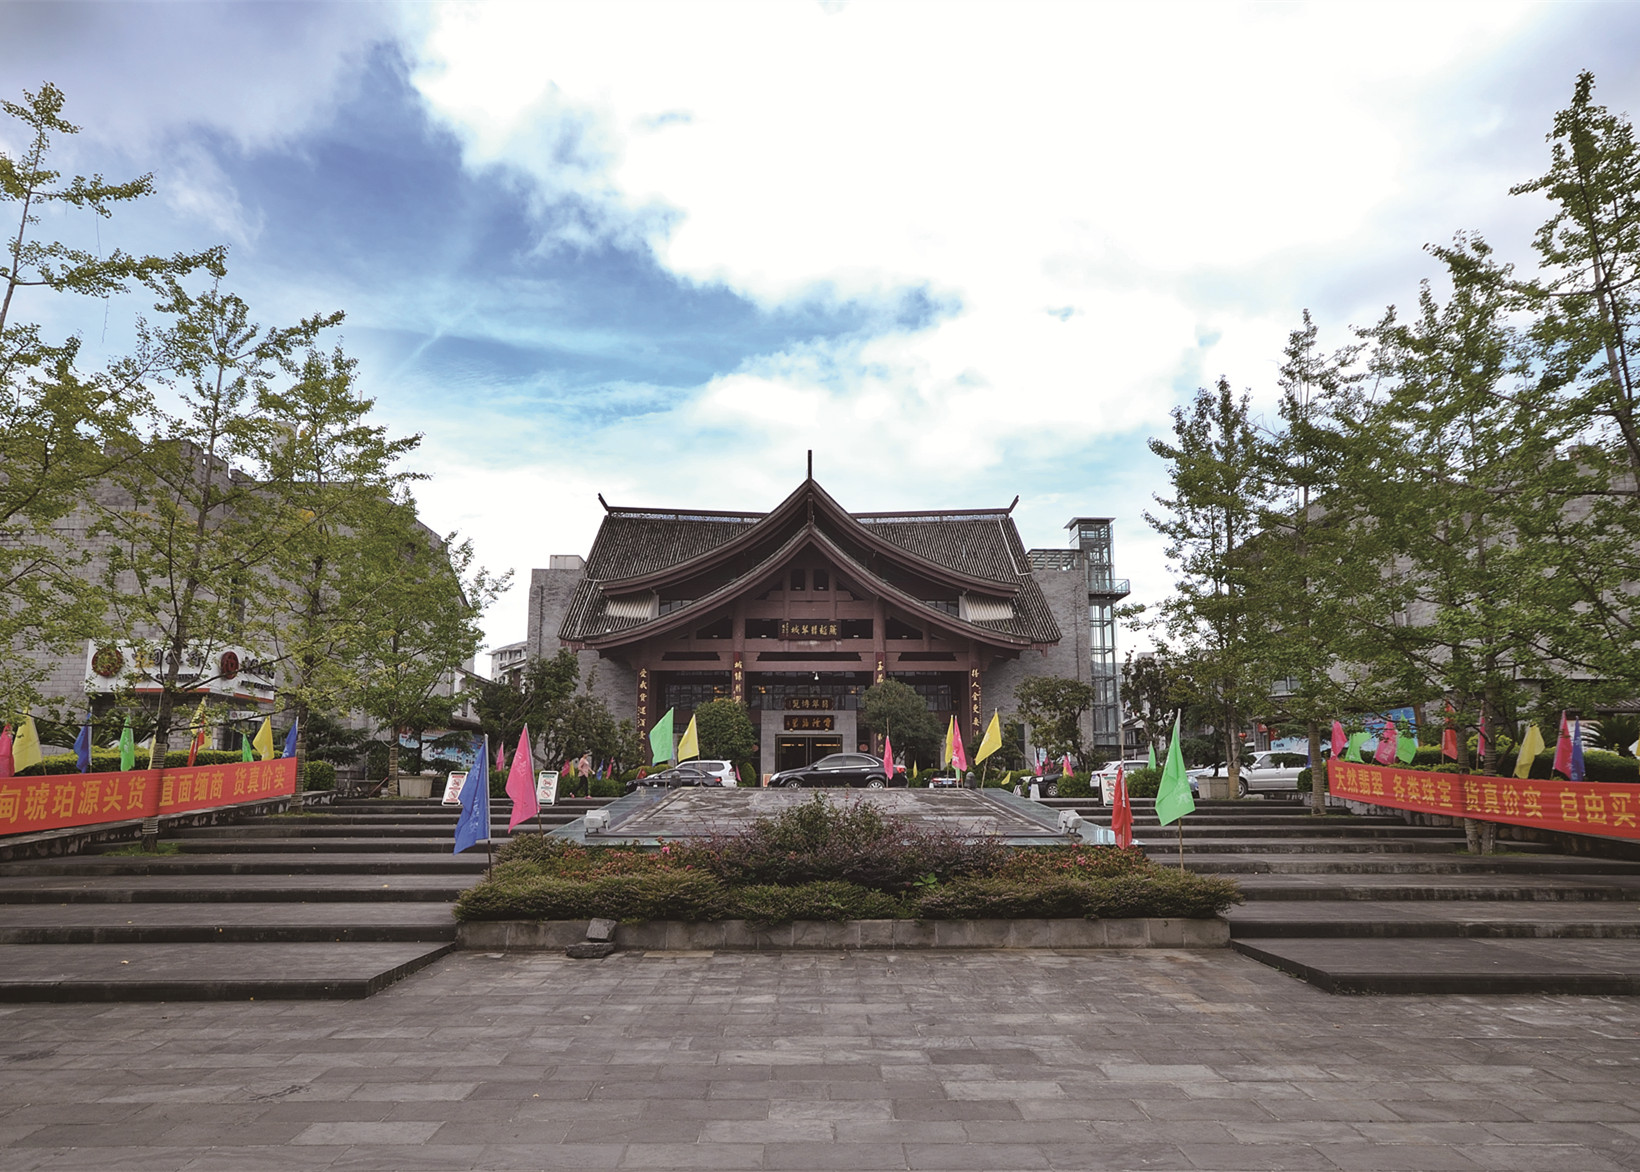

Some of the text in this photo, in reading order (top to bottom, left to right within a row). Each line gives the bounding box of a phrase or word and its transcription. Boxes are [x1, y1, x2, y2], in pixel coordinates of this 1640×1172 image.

[0, 763, 285, 824] 甸琥珀源头货 直面缅商 货真价实
[1335, 766, 1640, 829] 天然翡翠 各类珠宝 货真价实 自由买
